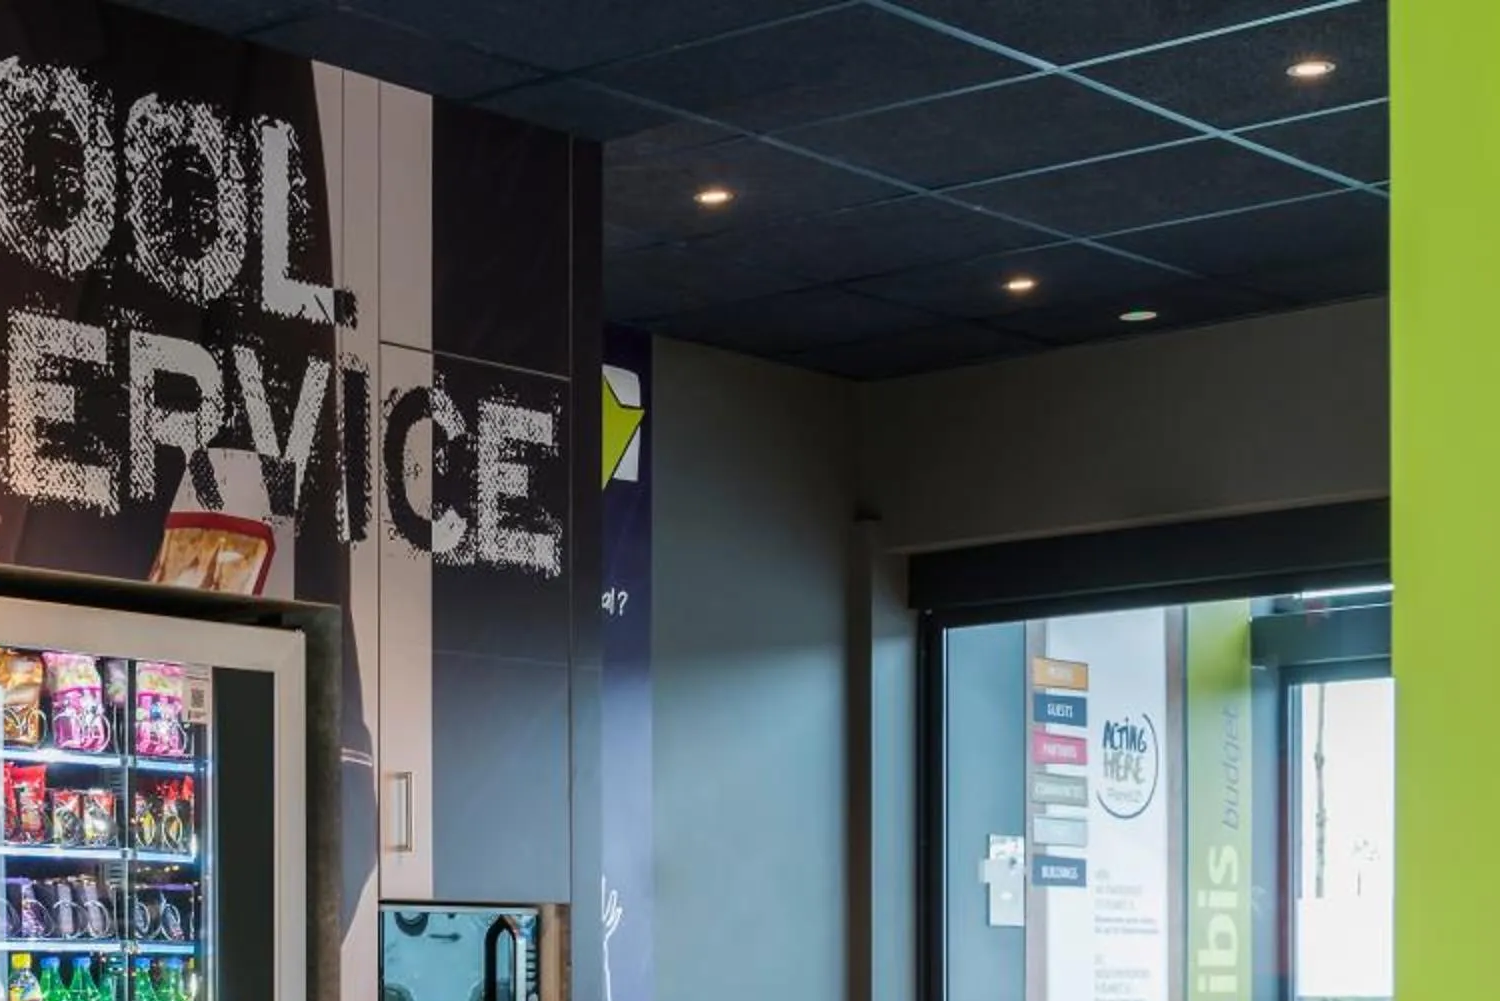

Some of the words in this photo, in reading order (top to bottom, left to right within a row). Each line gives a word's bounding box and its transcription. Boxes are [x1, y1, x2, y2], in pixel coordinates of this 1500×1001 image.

[1102, 716, 1148, 753] ACTING
[1103, 750, 1146, 784] HERE
[1197, 845, 1239, 993] ibis
